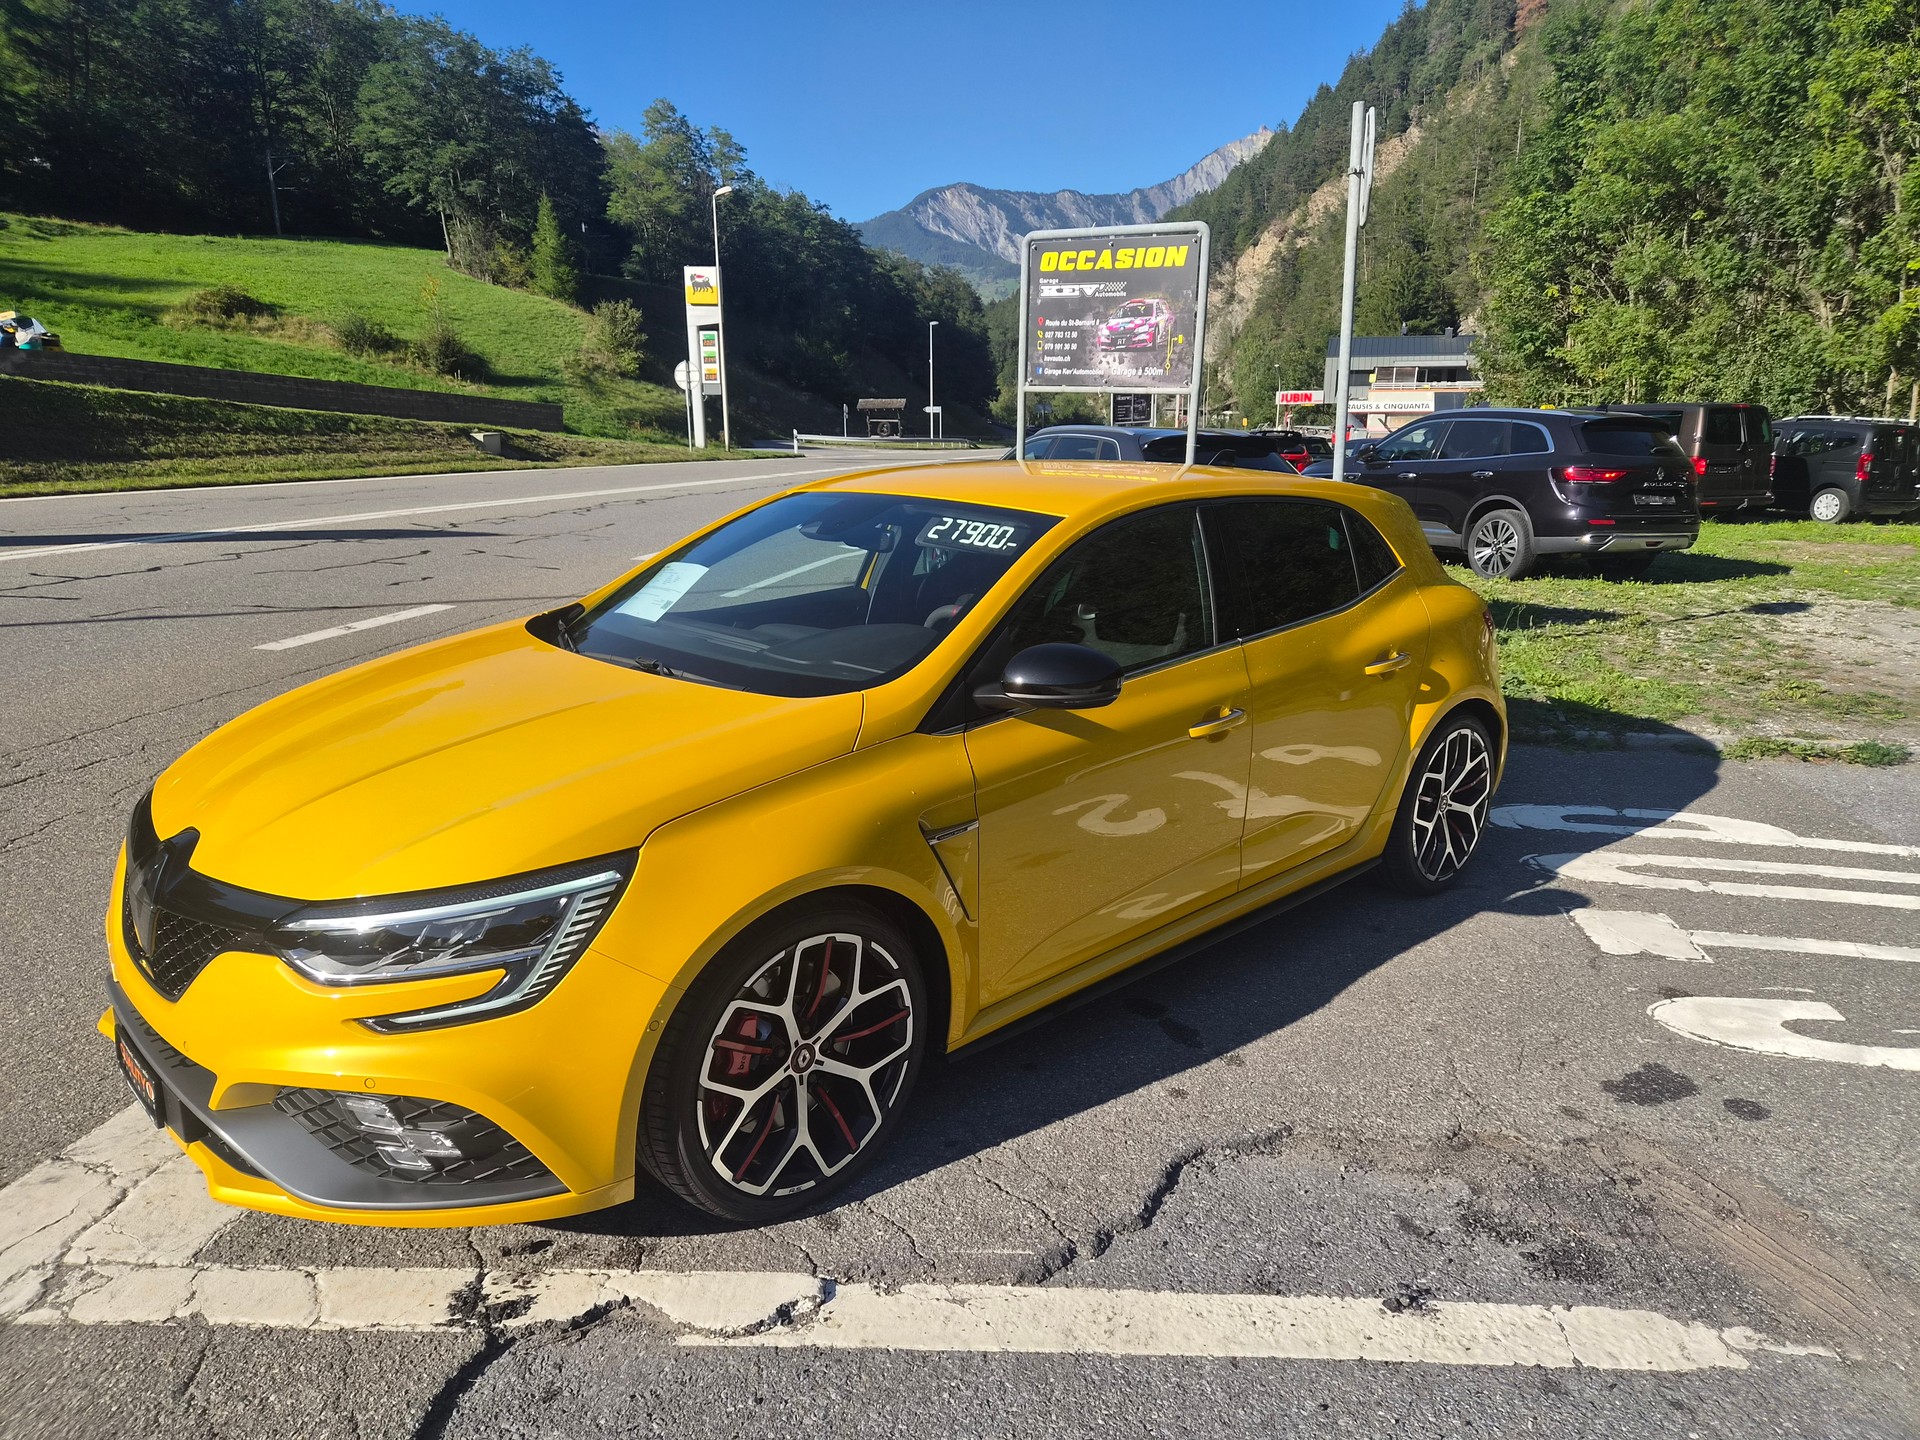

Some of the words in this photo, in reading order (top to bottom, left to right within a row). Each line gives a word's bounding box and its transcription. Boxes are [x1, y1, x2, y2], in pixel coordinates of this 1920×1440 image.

[1040, 246, 1189, 271] OCCASION
[1068, 318, 1096, 326] St-Bernard
[1044, 368, 1062, 376] Garage
[1111, 367, 1136, 377] Garage
[1137, 367, 1143, 375] à
[1143, 367, 1164, 375] 500m
[1281, 393, 1312, 403] JUBIN
